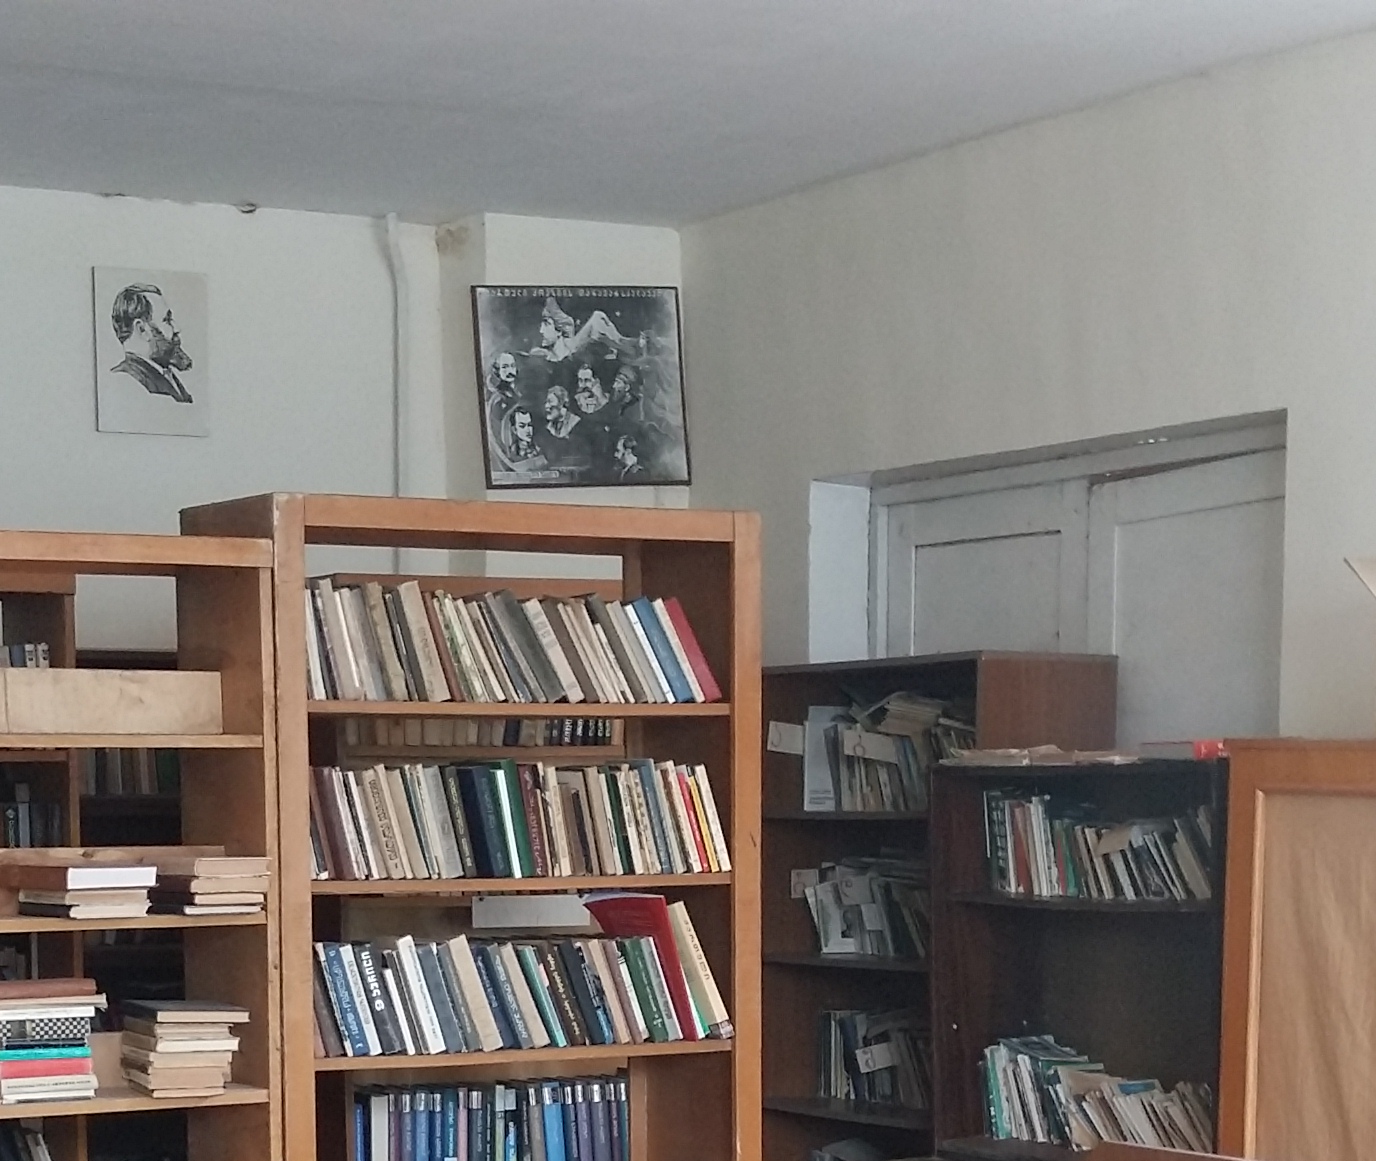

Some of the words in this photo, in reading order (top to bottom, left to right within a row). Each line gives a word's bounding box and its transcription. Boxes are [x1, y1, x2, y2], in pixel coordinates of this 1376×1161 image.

[485, 288, 528, 298] ართული
[578, 288, 666, 298] თანავარსკვლავედ
[360, 951, 382, 998] აპრილი
